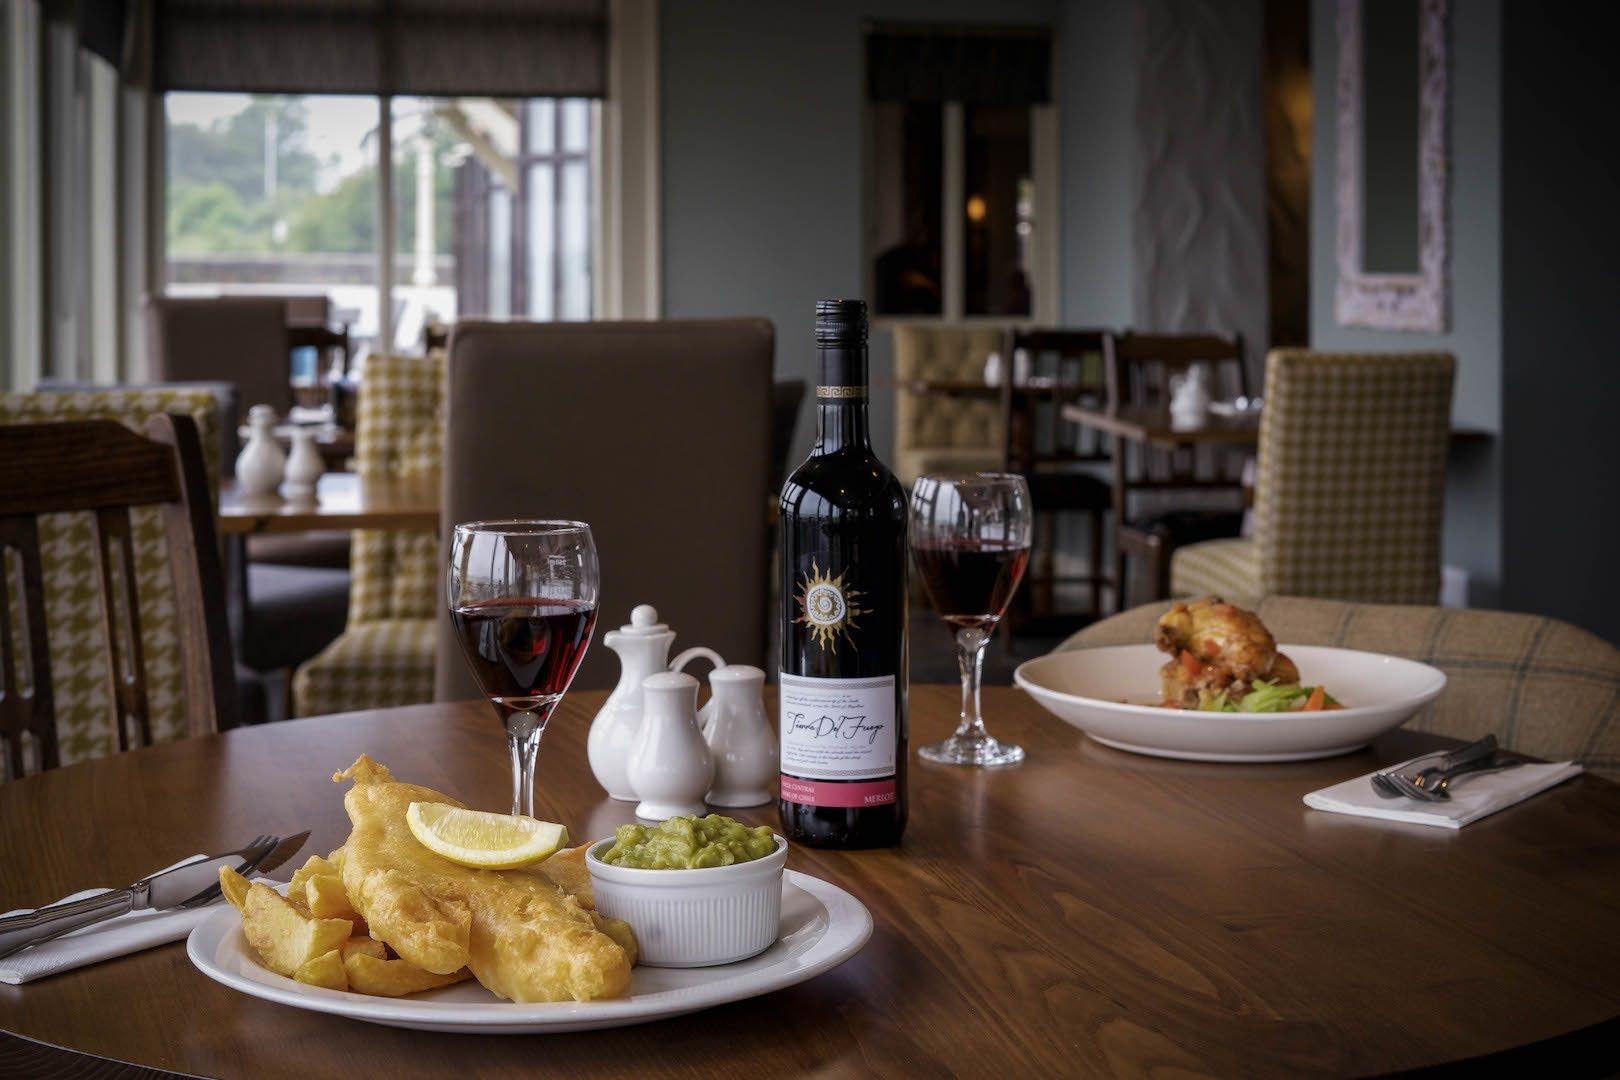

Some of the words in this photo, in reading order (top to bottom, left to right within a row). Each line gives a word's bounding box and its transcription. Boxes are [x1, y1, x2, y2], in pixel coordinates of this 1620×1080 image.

[814, 715, 847, 739] Del
[843, 715, 884, 745] Fuego
[864, 792, 894, 804] MERLOT
